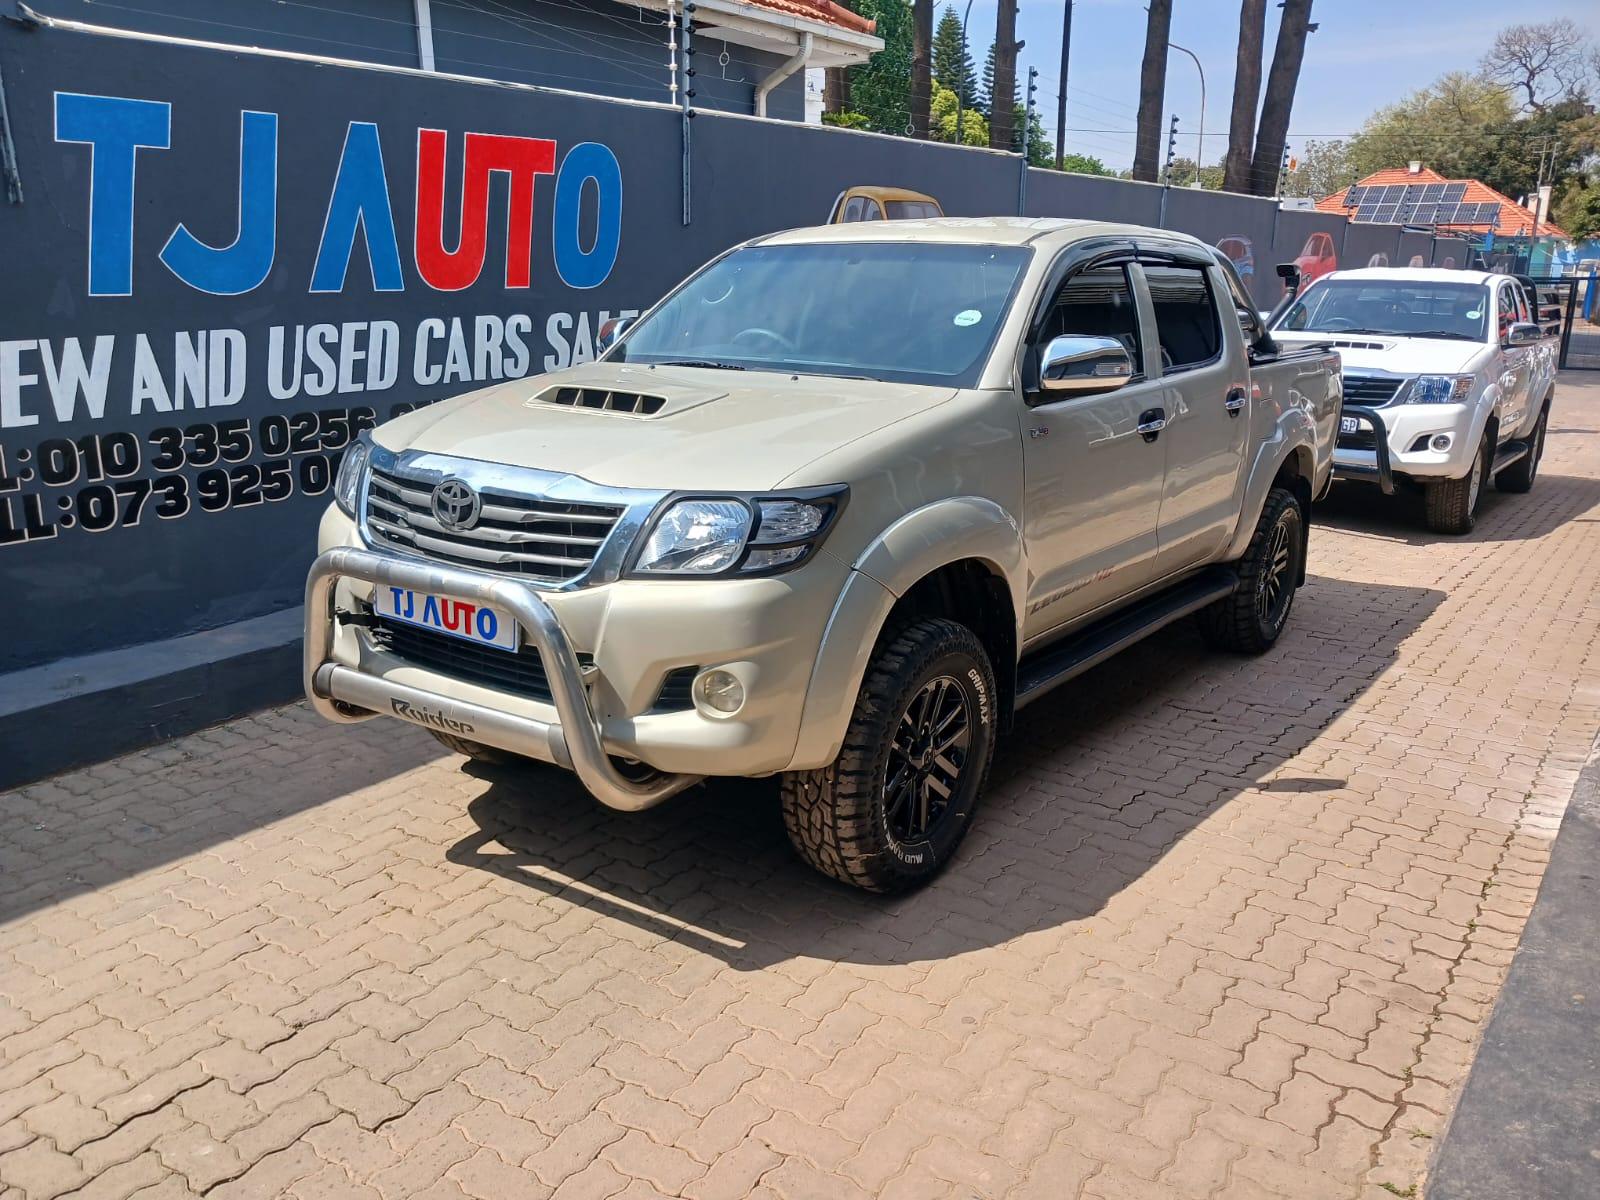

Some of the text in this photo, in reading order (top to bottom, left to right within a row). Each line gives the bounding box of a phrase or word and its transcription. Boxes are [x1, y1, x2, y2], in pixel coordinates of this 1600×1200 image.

[54, 91, 623, 297] TJ AUTO
[131, 328, 247, 415] AND
[267, 320, 400, 400] USED
[413, 314, 533, 386] CARS
[148, 418, 253, 472] 335
[197, 459, 294, 511] 925
[390, 587, 498, 641] TJ AUTO
[967, 668, 989, 725] GRIPMAX
